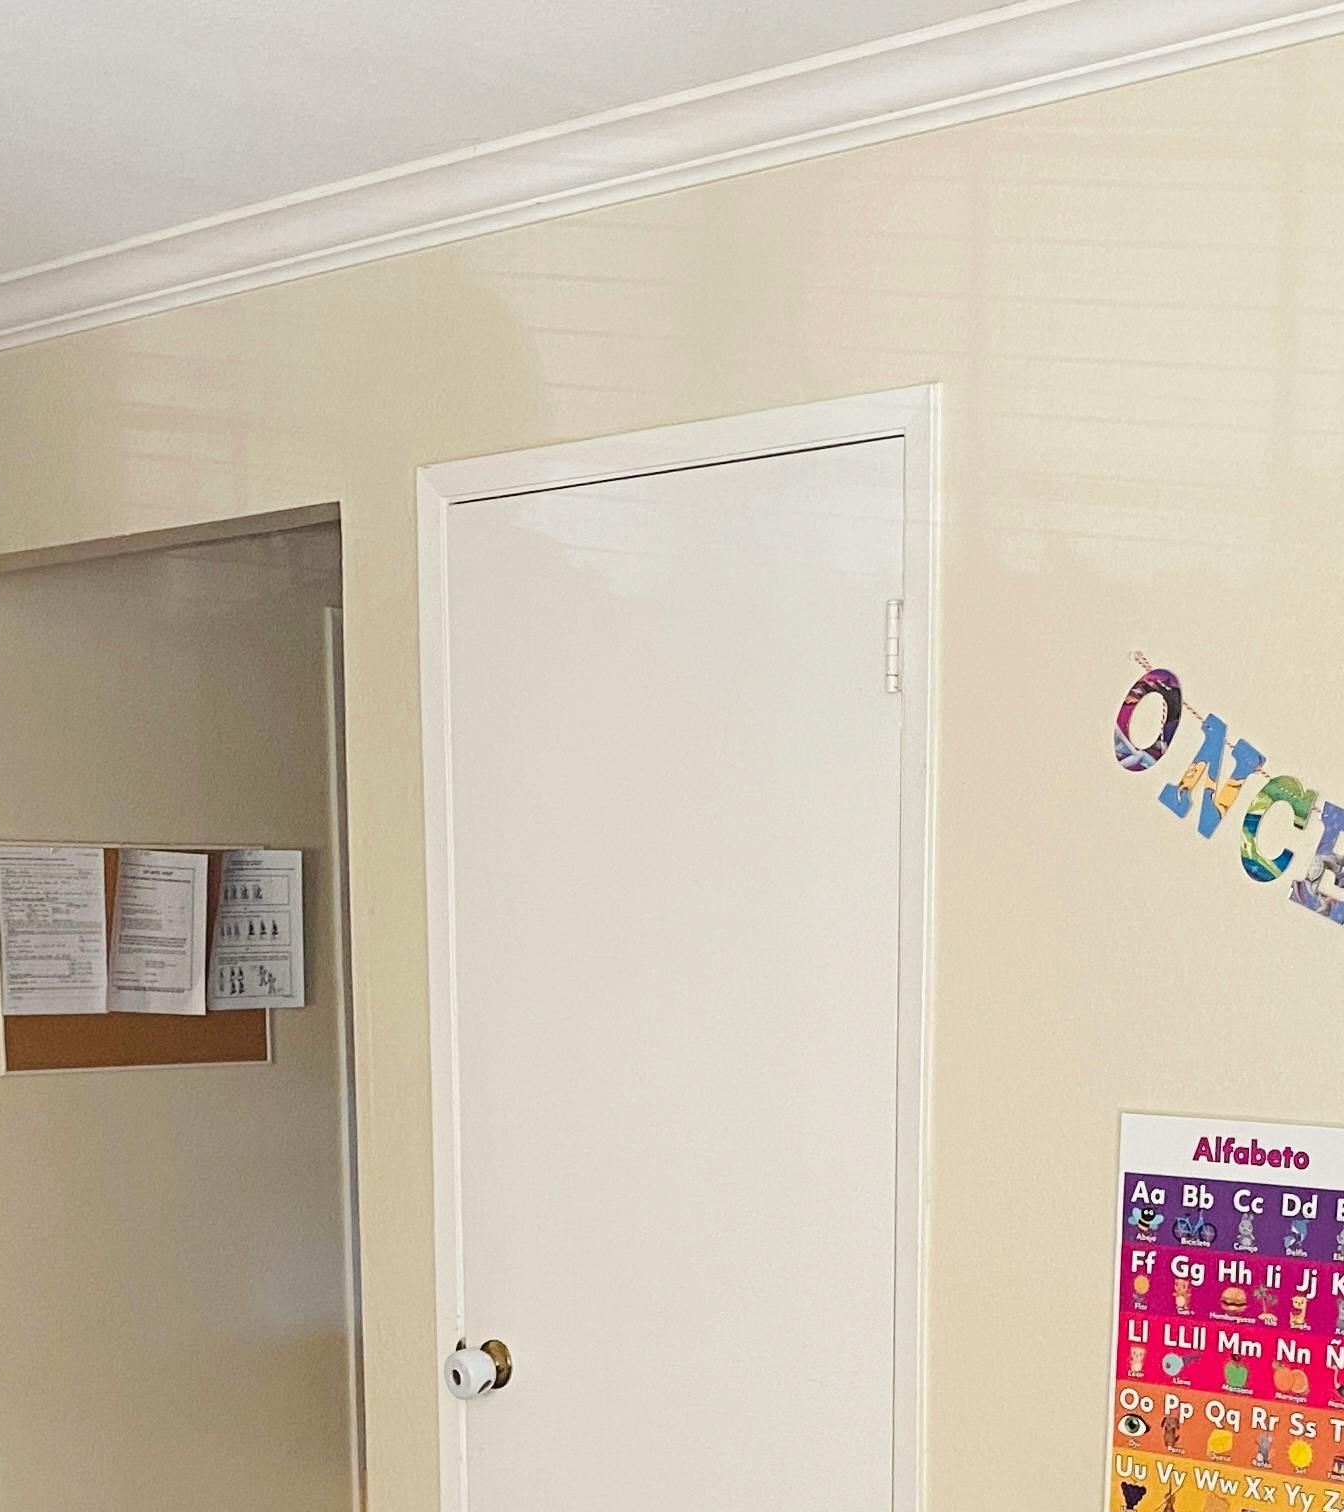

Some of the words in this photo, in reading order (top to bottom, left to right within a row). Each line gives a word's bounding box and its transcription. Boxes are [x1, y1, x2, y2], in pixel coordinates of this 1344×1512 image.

[1192, 1136, 1310, 1170] Alfabeto
[1130, 1180, 1166, 1205] Aa
[1182, 1184, 1214, 1209] Bb
[1233, 1189, 1264, 1214] Cc
[1281, 1193, 1319, 1219] Dd
[1130, 1250, 1156, 1274] Ff
[1170, 1255, 1206, 1286] Gg
[1217, 1259, 1252, 1285] Hh
[1266, 1264, 1282, 1288] Ii
[1295, 1268, 1319, 1300] Jj
[1128, 1319, 1149, 1343] Ll
[1217, 1331, 1262, 1358] Mm
[1276, 1338, 1311, 1364] Nn
[1119, 1388, 1154, 1413] Oo
[1164, 1393, 1194, 1424] Pp
[1205, 1400, 1241, 1432] Qq
[1251, 1406, 1280, 1432] Rr
[1289, 1411, 1317, 1439] Ss
[1115, 1454, 1147, 1481] Uu
[1156, 1460, 1186, 1488] Vv
[1193, 1467, 1240, 1496] Ww
[1243, 1475, 1276, 1502] Xx
